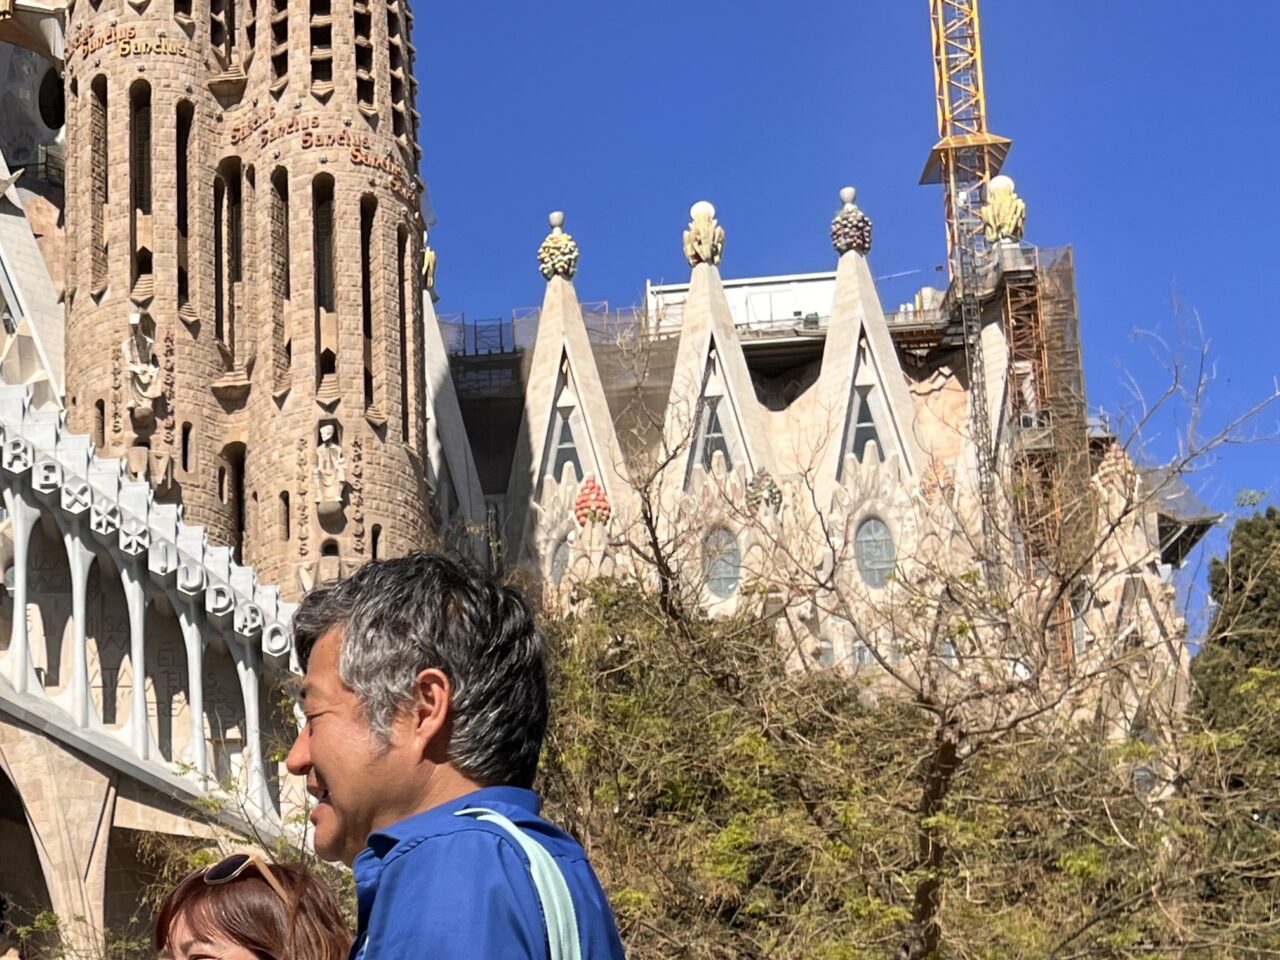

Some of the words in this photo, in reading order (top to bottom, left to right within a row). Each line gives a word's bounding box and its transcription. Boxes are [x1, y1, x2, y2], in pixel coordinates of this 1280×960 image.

[120, 37, 187, 57] Sanctus
[302, 128, 370, 149] Sanctus
[6, 438, 90, 510] REX
